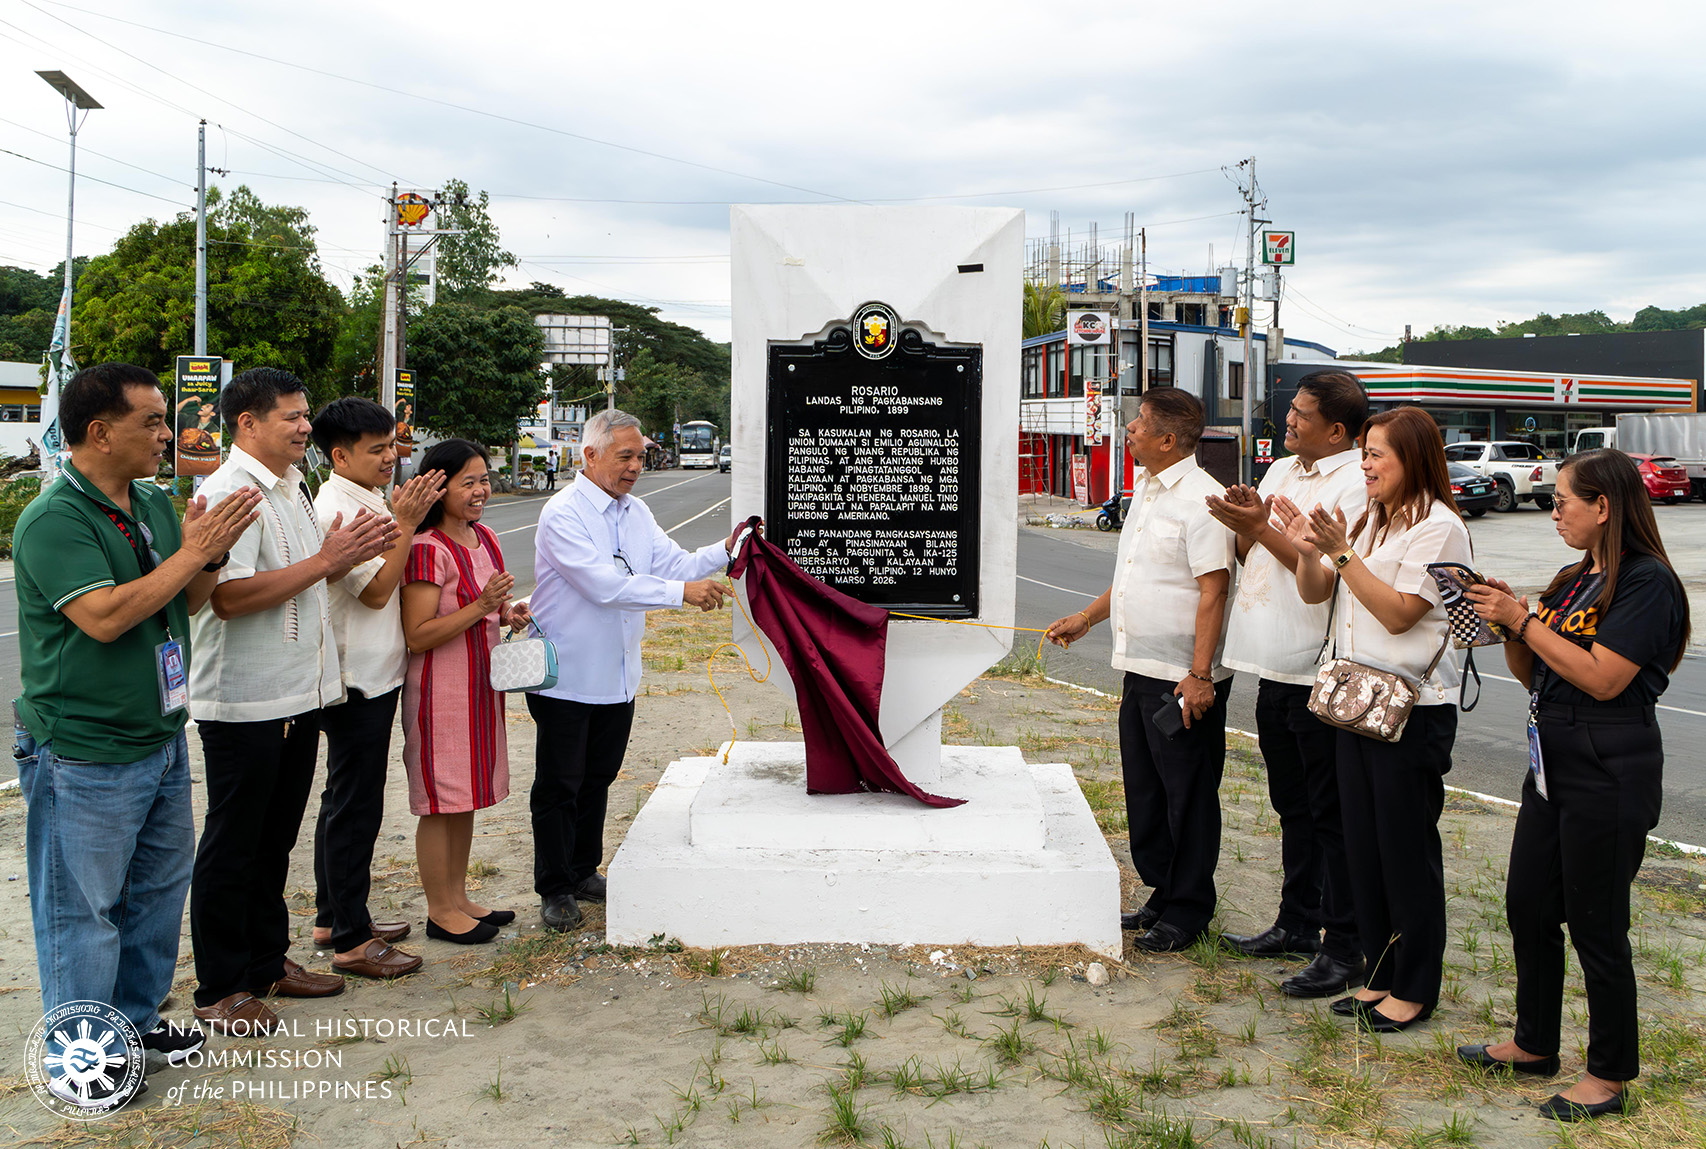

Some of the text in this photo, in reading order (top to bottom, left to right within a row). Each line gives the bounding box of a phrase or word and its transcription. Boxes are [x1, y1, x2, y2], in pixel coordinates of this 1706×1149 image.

[851, 386, 898, 396] ROSARIO
[806, 397, 943, 405] LANDAS NG PAGKABANSANG
[840, 405, 909, 414] PILIPINO, 1899
[798, 429, 959, 438] SA KASUKALAN NG ROSARIO, LA
[789, 438, 959, 448] UNION DUMAAN SI EMILIO AGUINALDO,
[789, 447, 959, 457] PANGULO NG UNANG REPUBLIKA NG
[788, 456, 959, 466] PILIPINAS, AT ANG KANIYANG HUKBO
[788, 465, 958, 475] HABANG IPINAGTATANGGOL ANG
[788, 475, 958, 484] KALAYAAN AT PAGKABANSA NG MGA
[788, 484, 958, 493] PILIPINO, 16 NOBYEMBRE 1899. DITO
[788, 493, 958, 502] NAKIPAGKITA SI HENERAL MANUEL TINIO
[788, 502, 958, 512] UPANG IULAT NA PAPALAPIT NA ANG
[788, 511, 890, 520] HUKBONG AMERIKANO.
[797, 529, 958, 539] ANG PANANDANG PANGKASAYSAYANG
[787, 539, 957, 548] ITO AY PINASINAYAAN BILANG
[787, 548, 957, 557] AMBAG SA PAGGUNITA SA IKA-125
[789, 557, 957, 566] NIBERSARYO NG KALAYAAN AT
[869, 566, 906, 575] PILIPINO,
[913, 567, 922, 575] 12
[929, 567, 957, 575] HUNYO
[835, 575, 865, 584] MARSO
[873, 576, 897, 584] 2026.
